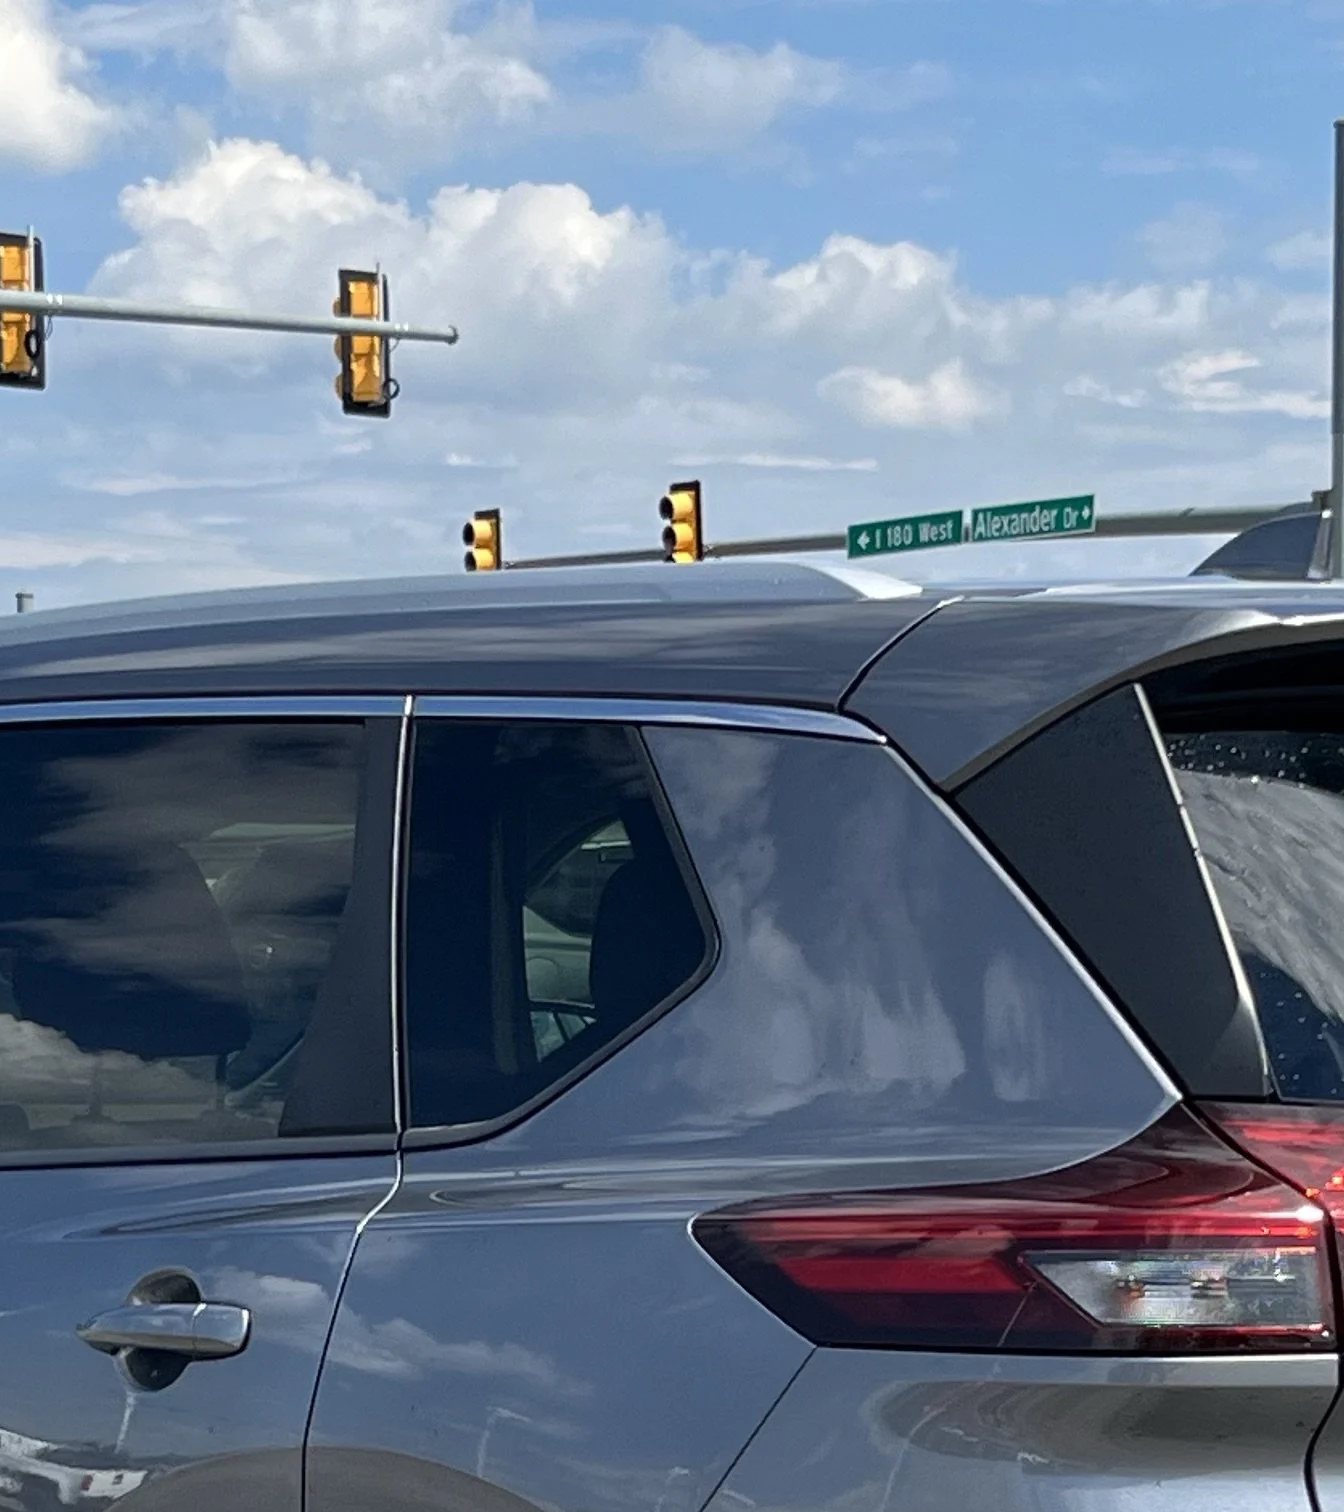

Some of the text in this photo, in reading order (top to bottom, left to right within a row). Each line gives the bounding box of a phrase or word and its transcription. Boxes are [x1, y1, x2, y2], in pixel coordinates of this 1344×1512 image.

[875, 520, 953, 549] I 180 West
[974, 505, 1078, 540] Alexander Dr
